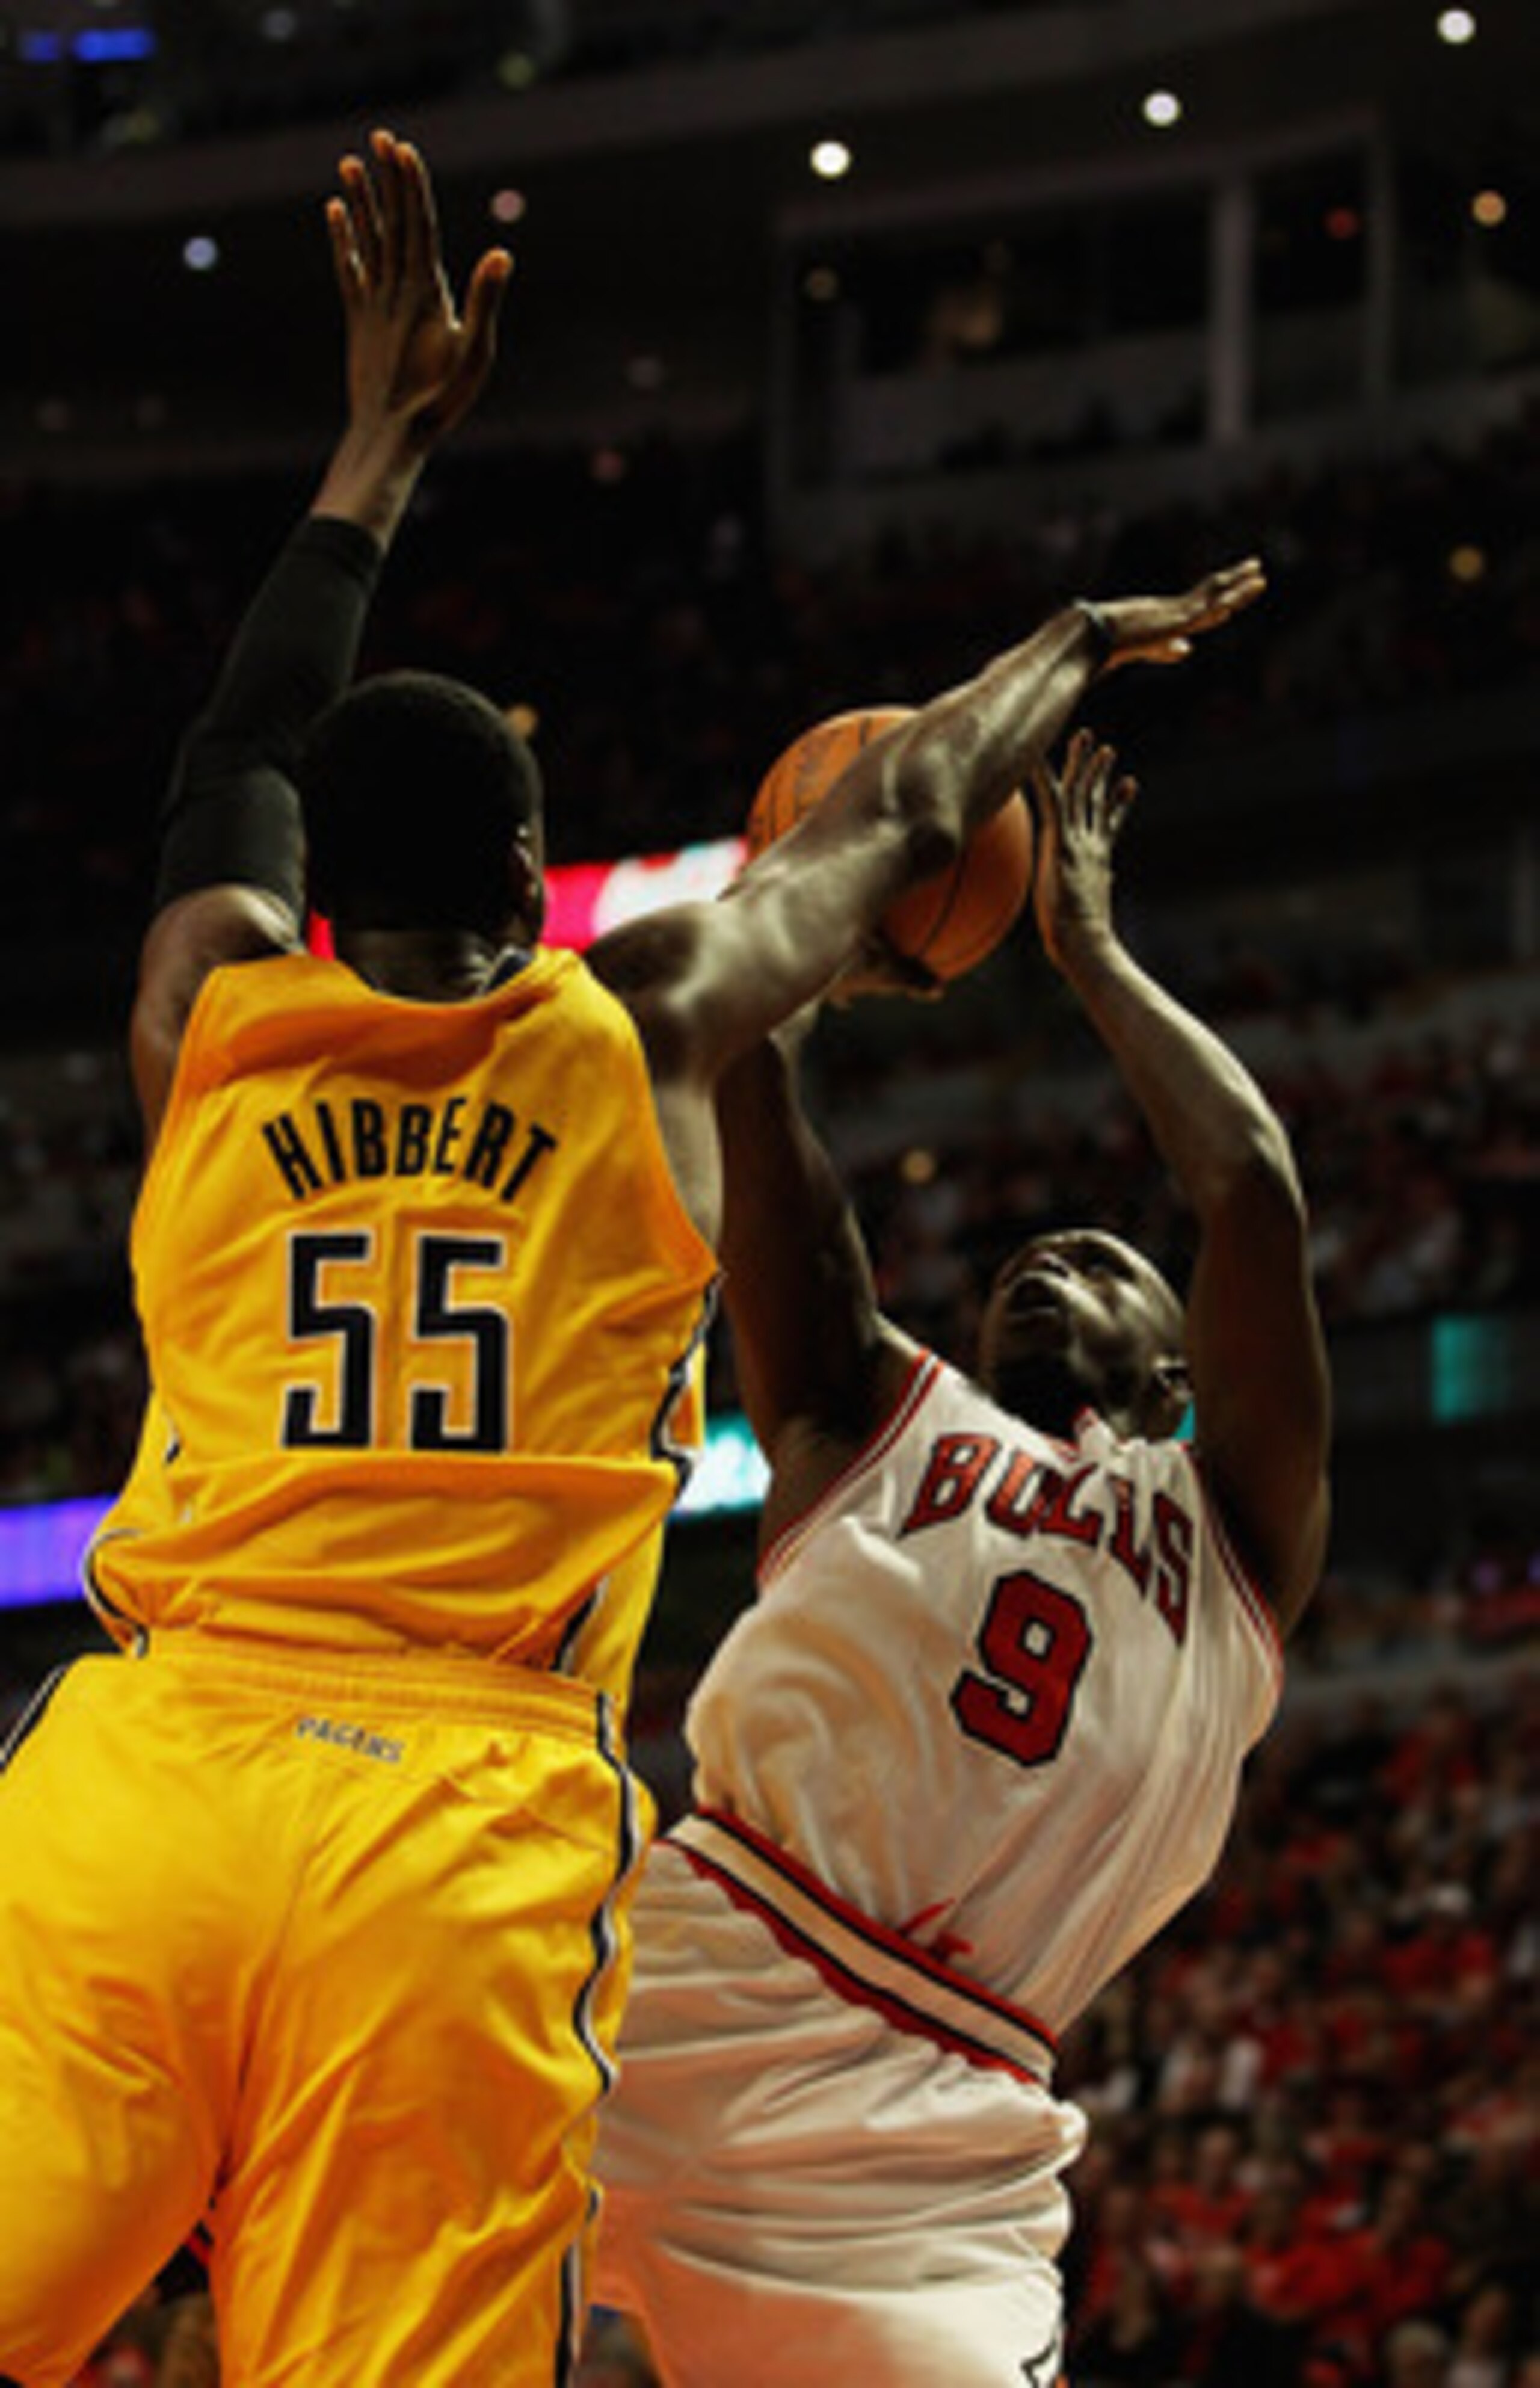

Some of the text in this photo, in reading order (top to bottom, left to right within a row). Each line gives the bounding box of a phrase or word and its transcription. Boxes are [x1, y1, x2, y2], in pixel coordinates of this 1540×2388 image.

[262, 1096, 558, 1201] HIBBERT
[281, 1230, 510, 1455] 55
[896, 1433, 1194, 1647] BULLS
[297, 1718, 405, 1764] PACERS
[949, 1569, 1094, 1768] 9
